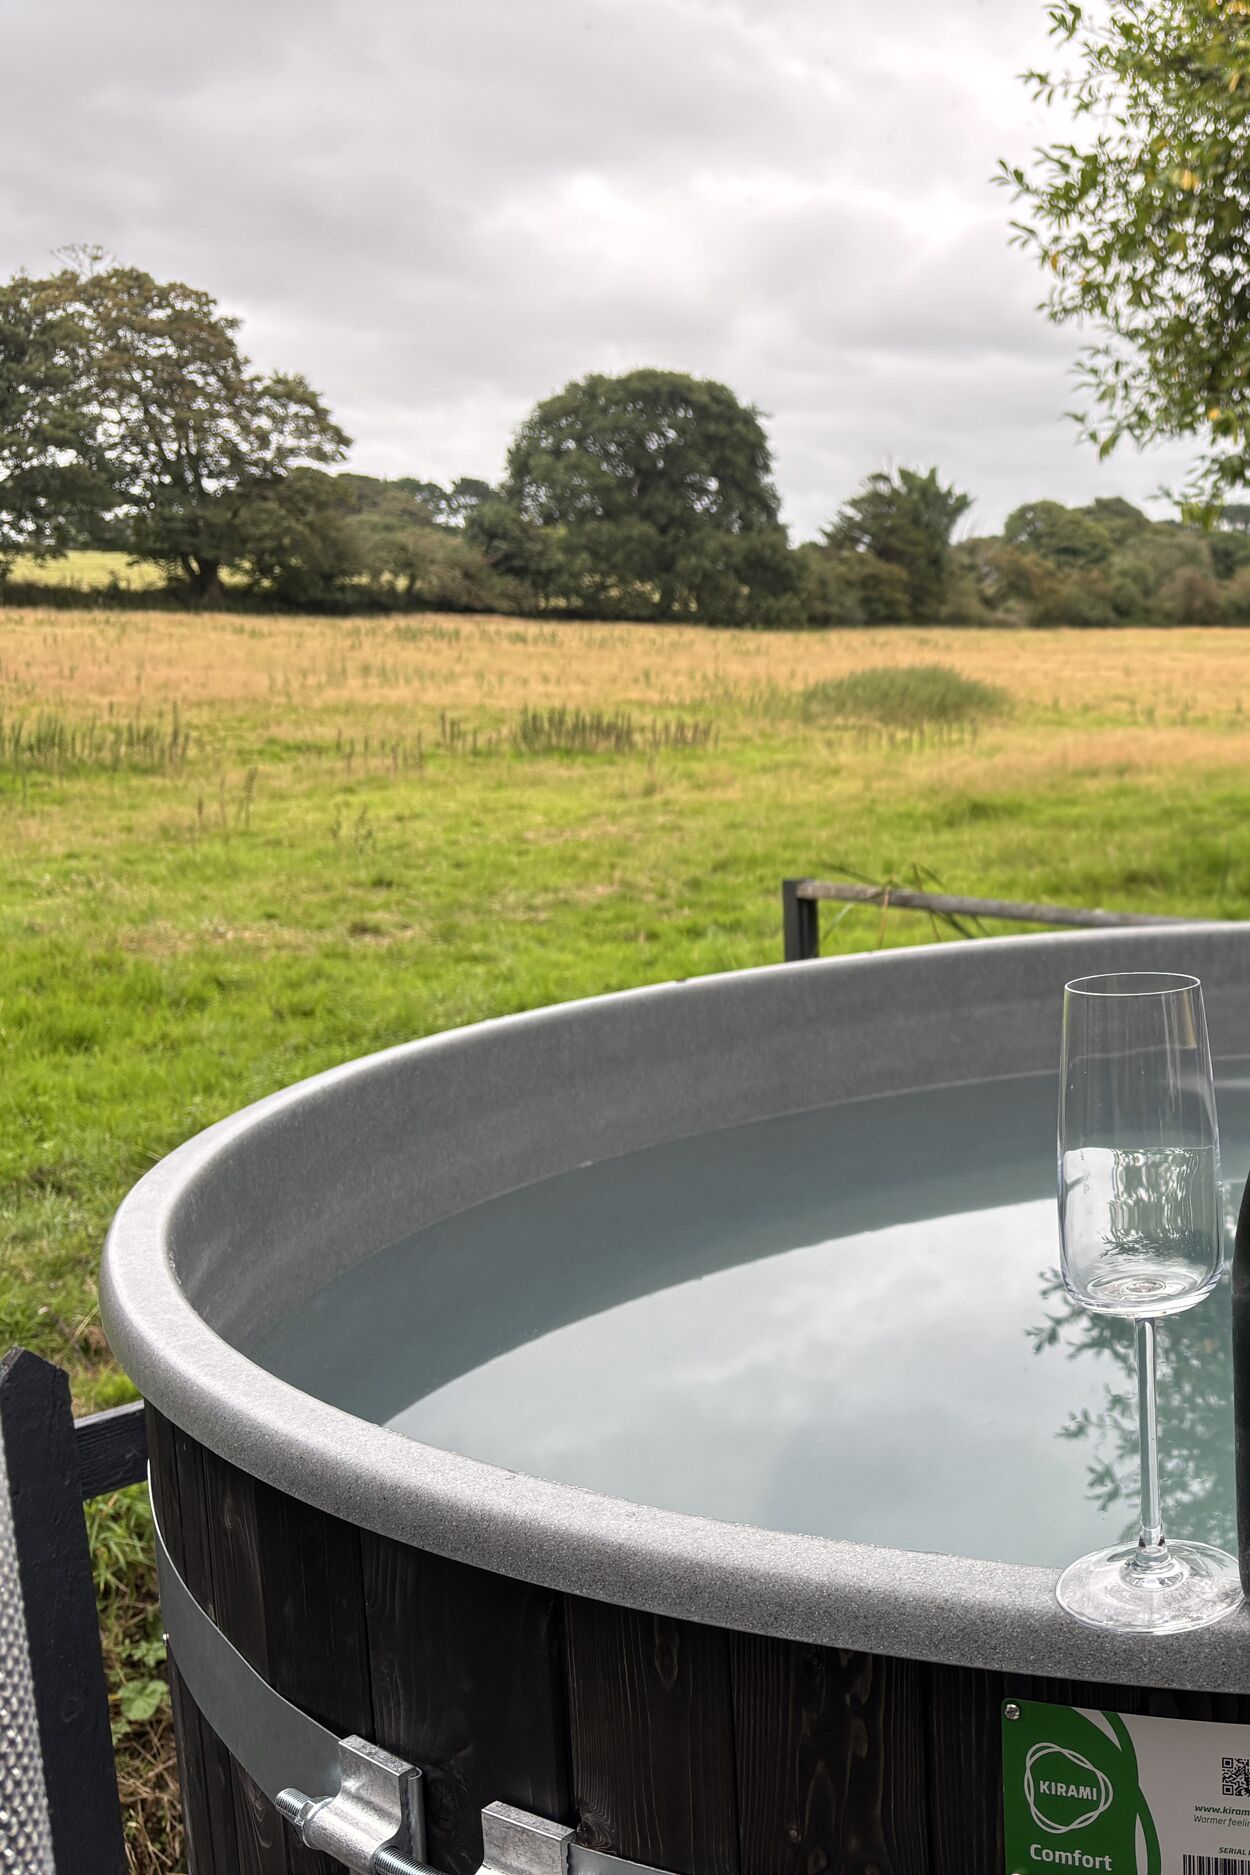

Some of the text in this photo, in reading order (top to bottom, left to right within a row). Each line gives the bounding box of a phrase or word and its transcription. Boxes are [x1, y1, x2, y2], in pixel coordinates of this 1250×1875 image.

[1039, 1780, 1098, 1801] KIRAMI
[1193, 1814, 1228, 1825] Warmer
[1029, 1843, 1113, 1872] Comfort
[1218, 1846, 1247, 1856] SERIAL
